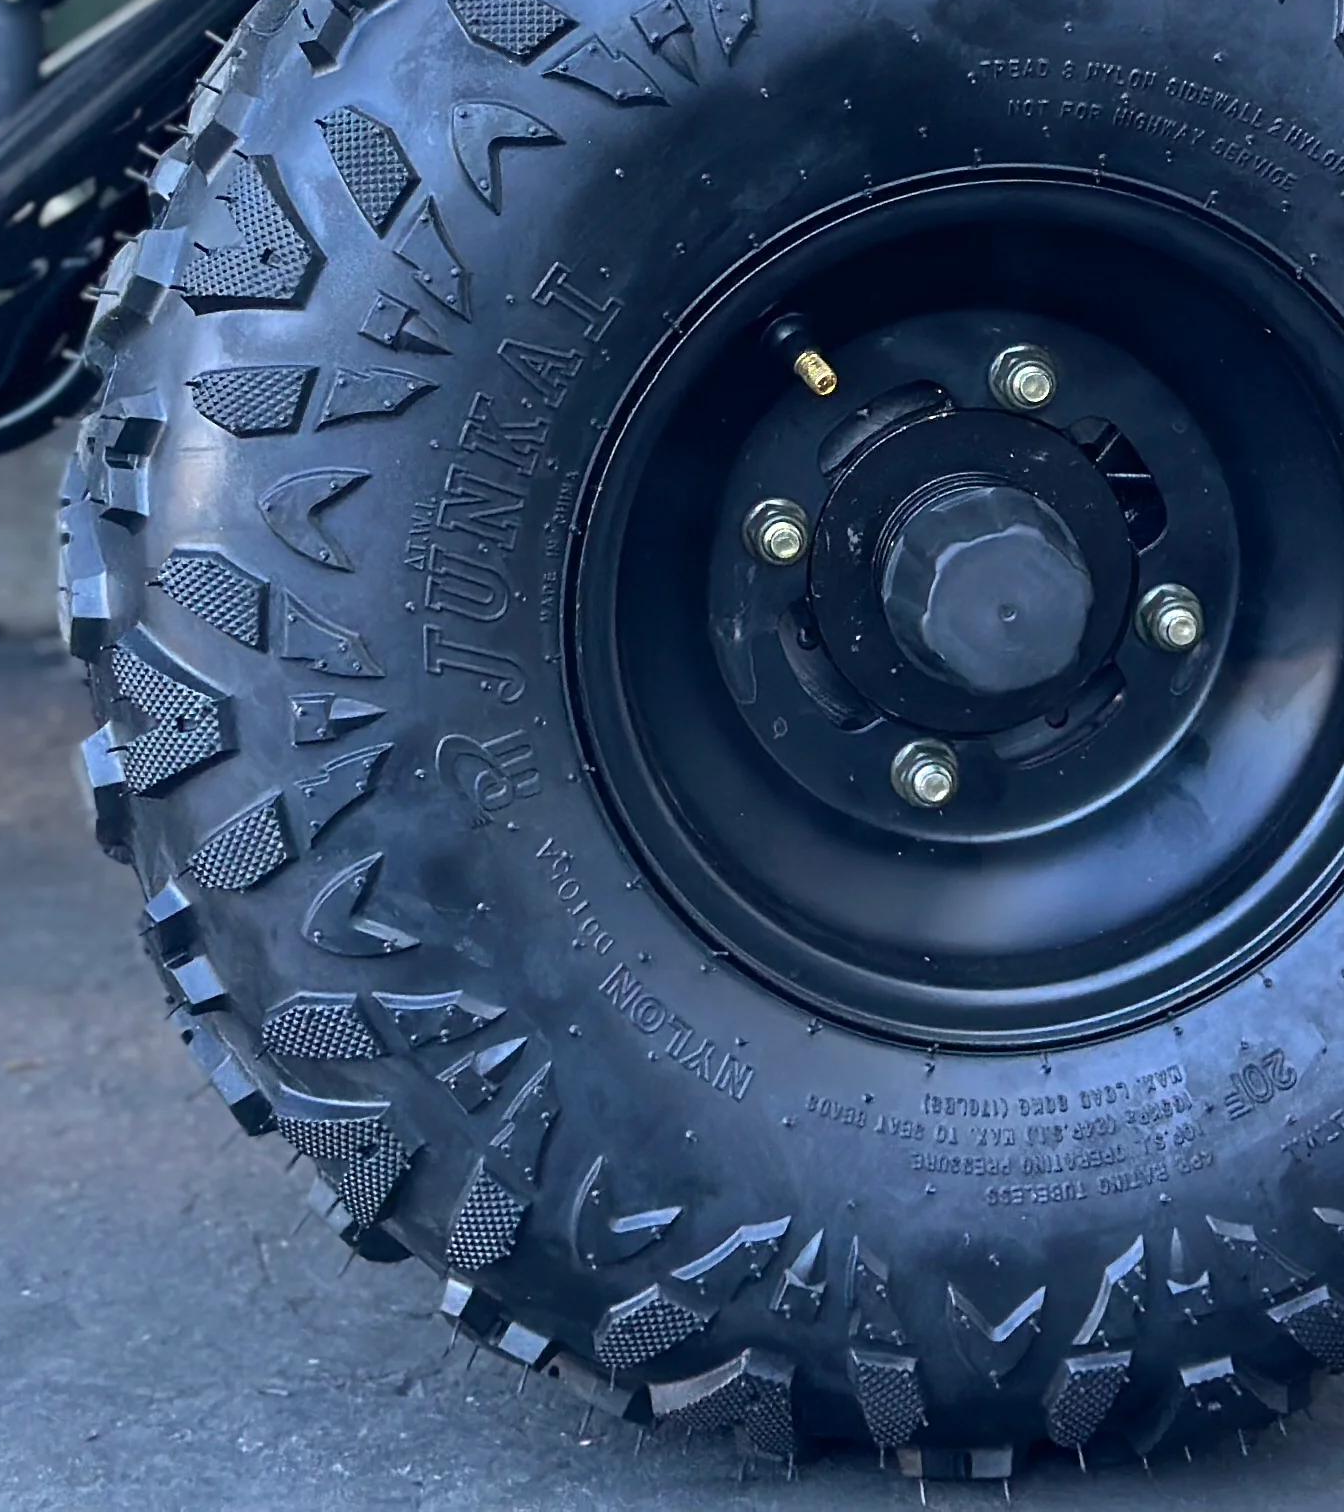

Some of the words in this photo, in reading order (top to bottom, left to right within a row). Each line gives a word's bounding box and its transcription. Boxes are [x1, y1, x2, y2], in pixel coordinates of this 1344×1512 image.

[978, 55, 1050, 80] TREAD
[1084, 57, 1157, 94] NYLON
[1163, 74, 1265, 129] SIDEWALL
[1007, 97, 1048, 118] NOT
[1058, 98, 1103, 123] FOR
[1114, 104, 1207, 149] HIGHWAY
[1210, 136, 1297, 193] SERVICE
[425, 261, 622, 704] JUNKAI
[552, 468, 580, 525] CHINA
[542, 537, 561, 558] IN
[537, 569, 556, 622] MADE
[599, 962, 756, 1101] NYLON
[1079, 1080, 1130, 1108] LOAD
[1134, 1063, 1184, 1095] MAX.
[804, 1091, 869, 1130] BEADS
[873, 1113, 925, 1142] SEAT
[935, 1124, 959, 1146] TO
[969, 1125, 1014, 1147] MAX.
[909, 1150, 1011, 1177] PRESSURE
[1023, 1142, 1126, 1173] OPERATING
[986, 1180, 1087, 1205] TUBELESS
[1096, 1162, 1170, 1196] RATING
